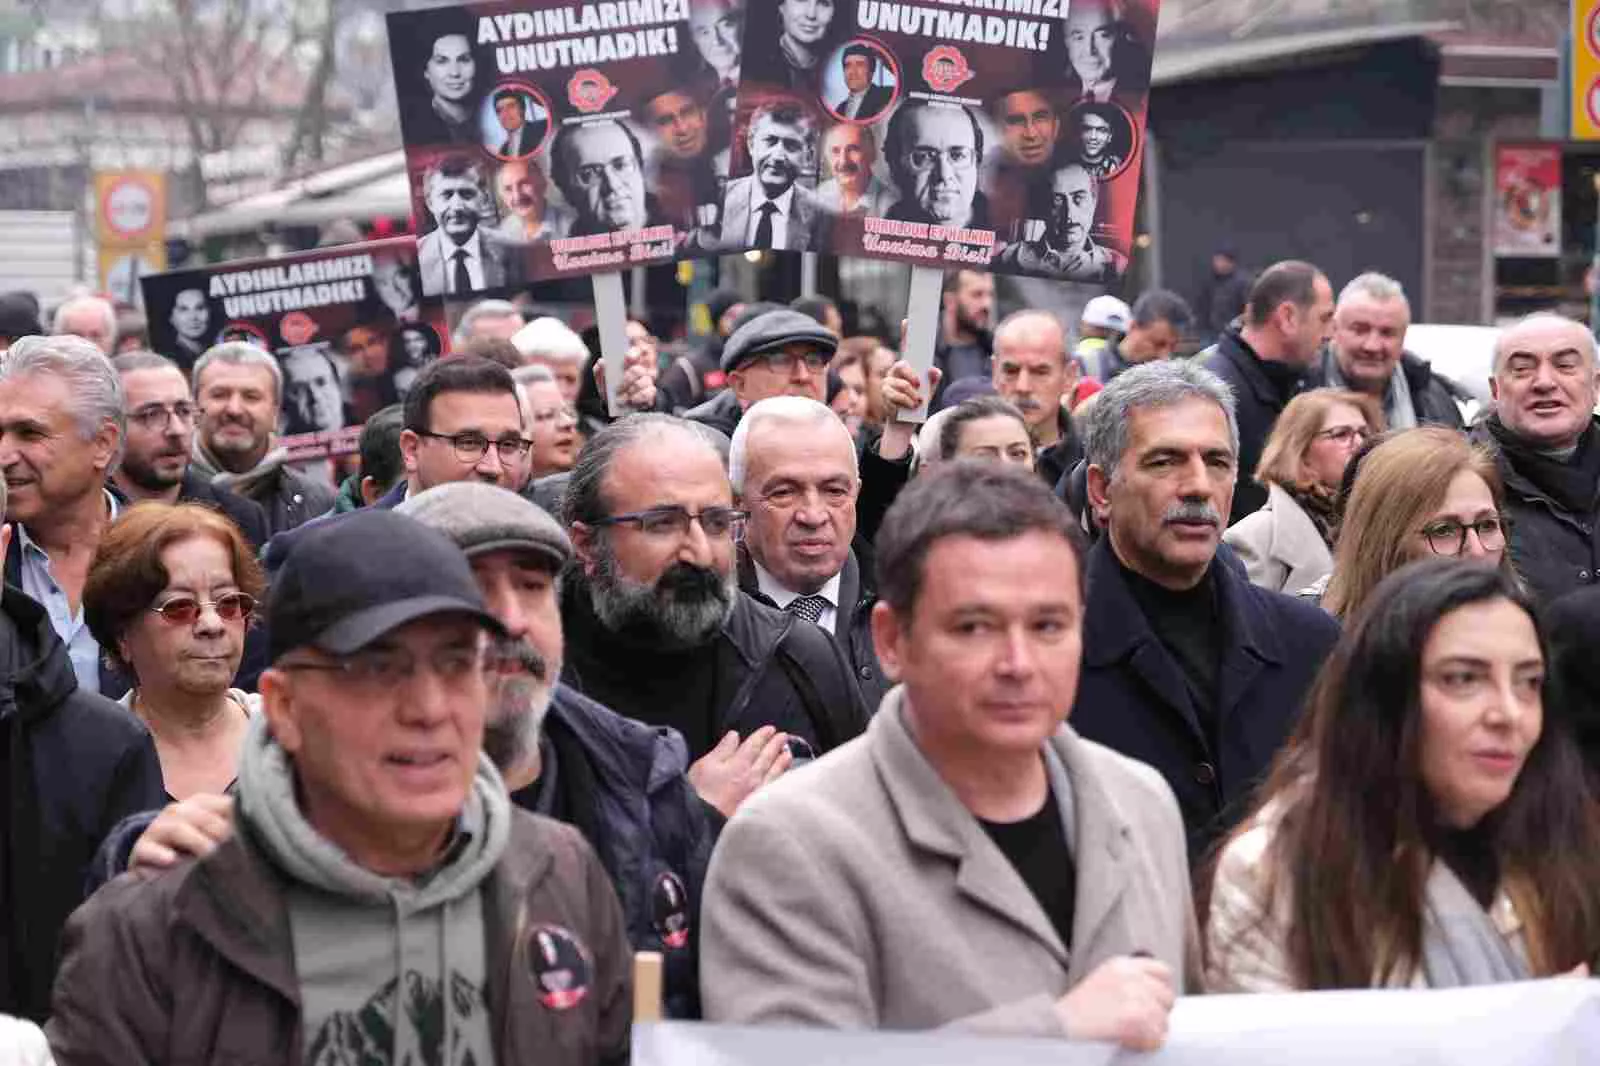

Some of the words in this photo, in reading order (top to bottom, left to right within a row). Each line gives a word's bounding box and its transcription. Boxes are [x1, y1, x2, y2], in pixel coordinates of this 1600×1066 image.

[477, 0, 690, 44] AYDINLARIMIZI
[857, 0, 1051, 52] UNUTMADIK!
[496, 27, 679, 74] UNUTMADIK!
[209, 254, 374, 297] AYDINLARIMIZI
[223, 278, 366, 319] UNUTMADIK!
